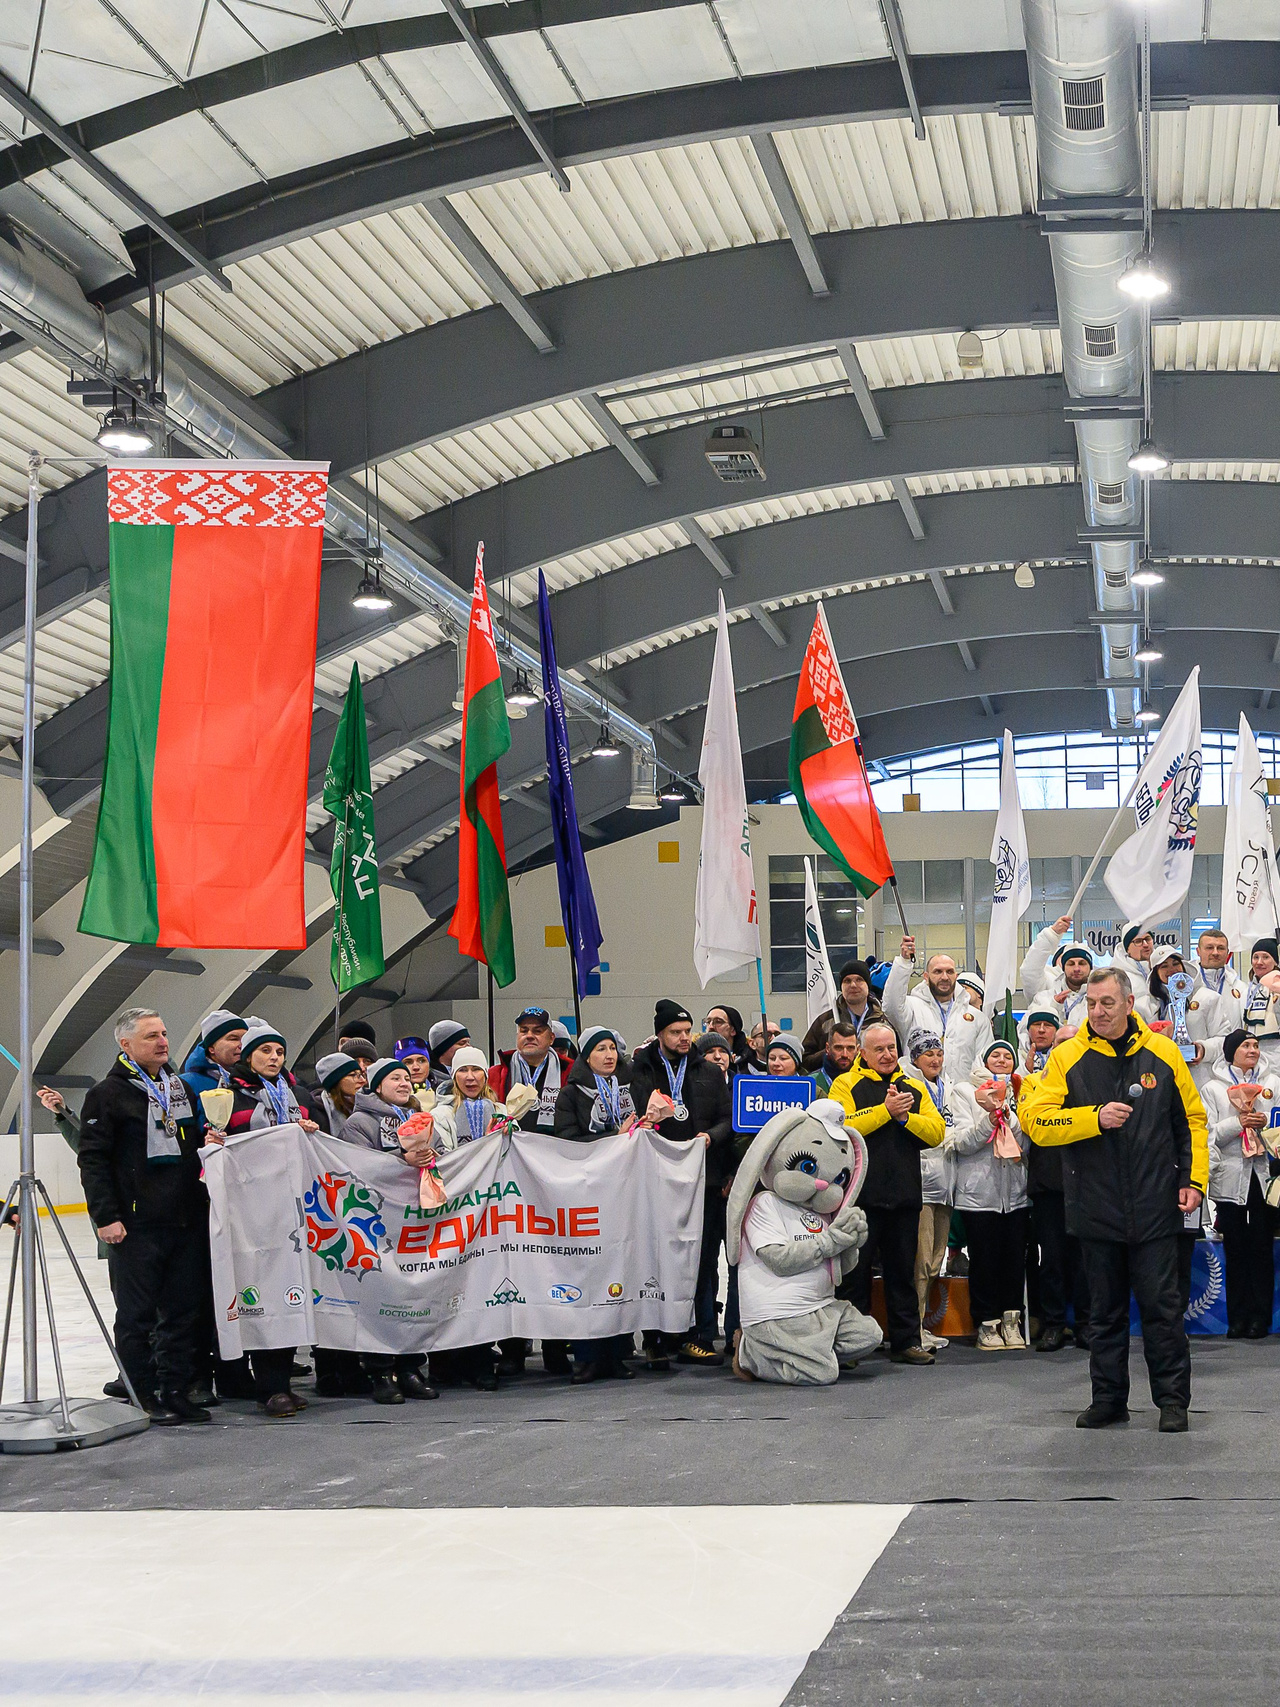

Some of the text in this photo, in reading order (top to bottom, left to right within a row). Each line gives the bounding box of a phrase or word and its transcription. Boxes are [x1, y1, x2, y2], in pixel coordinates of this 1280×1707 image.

[1136, 781, 1156, 826] БЕЛЫ
[397, 1204, 600, 1258] ЕДИНЫЕ
[399, 1261, 436, 1273] КОГДА
[439, 1258, 458, 1269] МЫ
[458, 1248, 485, 1266] ЕДИНЫ
[500, 1243, 519, 1253] МЫ
[522, 1244, 602, 1256] НЕПОБЕДИМЫ!
[379, 1307, 431, 1319] ВОСТОЧНЫЙ
